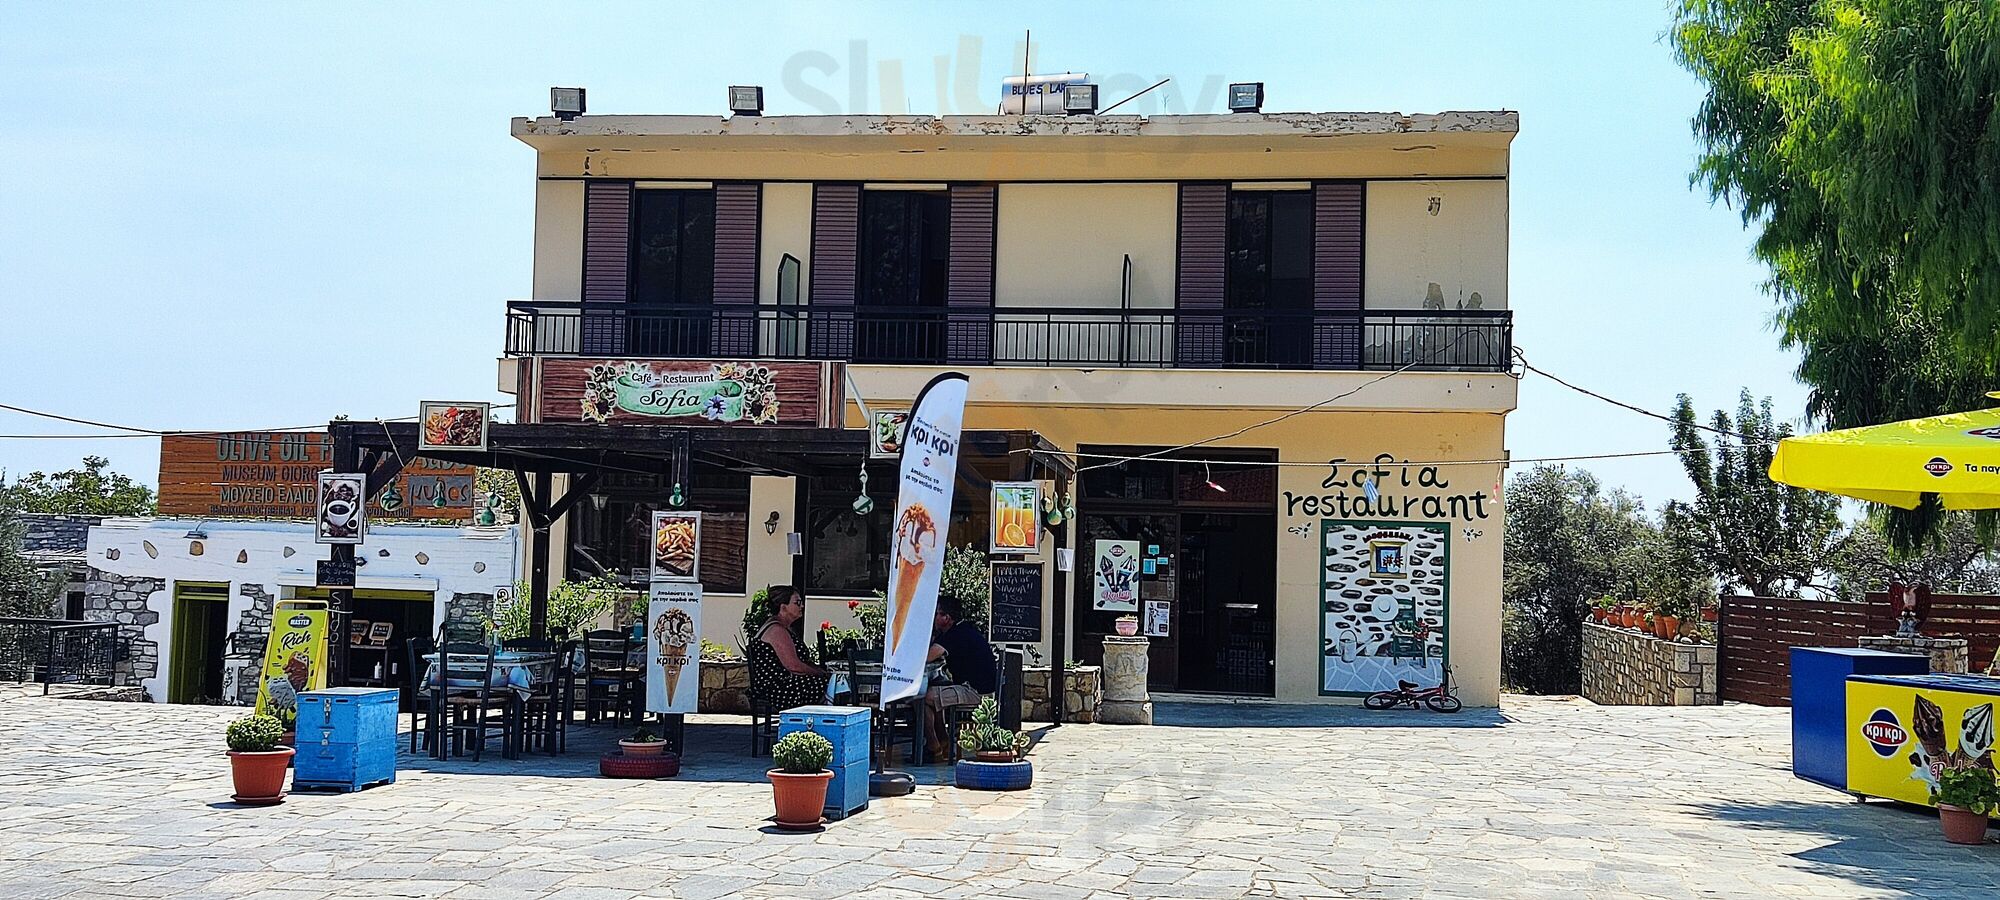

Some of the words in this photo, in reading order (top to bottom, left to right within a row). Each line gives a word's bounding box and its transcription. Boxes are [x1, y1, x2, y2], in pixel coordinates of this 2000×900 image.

[631, 372, 652, 384] Café
[663, 373, 715, 384] Restaurant
[639, 388, 701, 415] Sofia
[217, 433, 272, 462] OLIVE
[280, 433, 309, 462] OIL
[222, 465, 277, 482] MUSEUM
[281, 465, 320, 482] GIORG
[220, 487, 275, 503] ΜΟΥΣΕΙΟ
[278, 486, 317, 503] ΕΛΑΙΟ
[1283, 490, 1489, 522] restaurant
[281, 630, 312, 651] Rich
